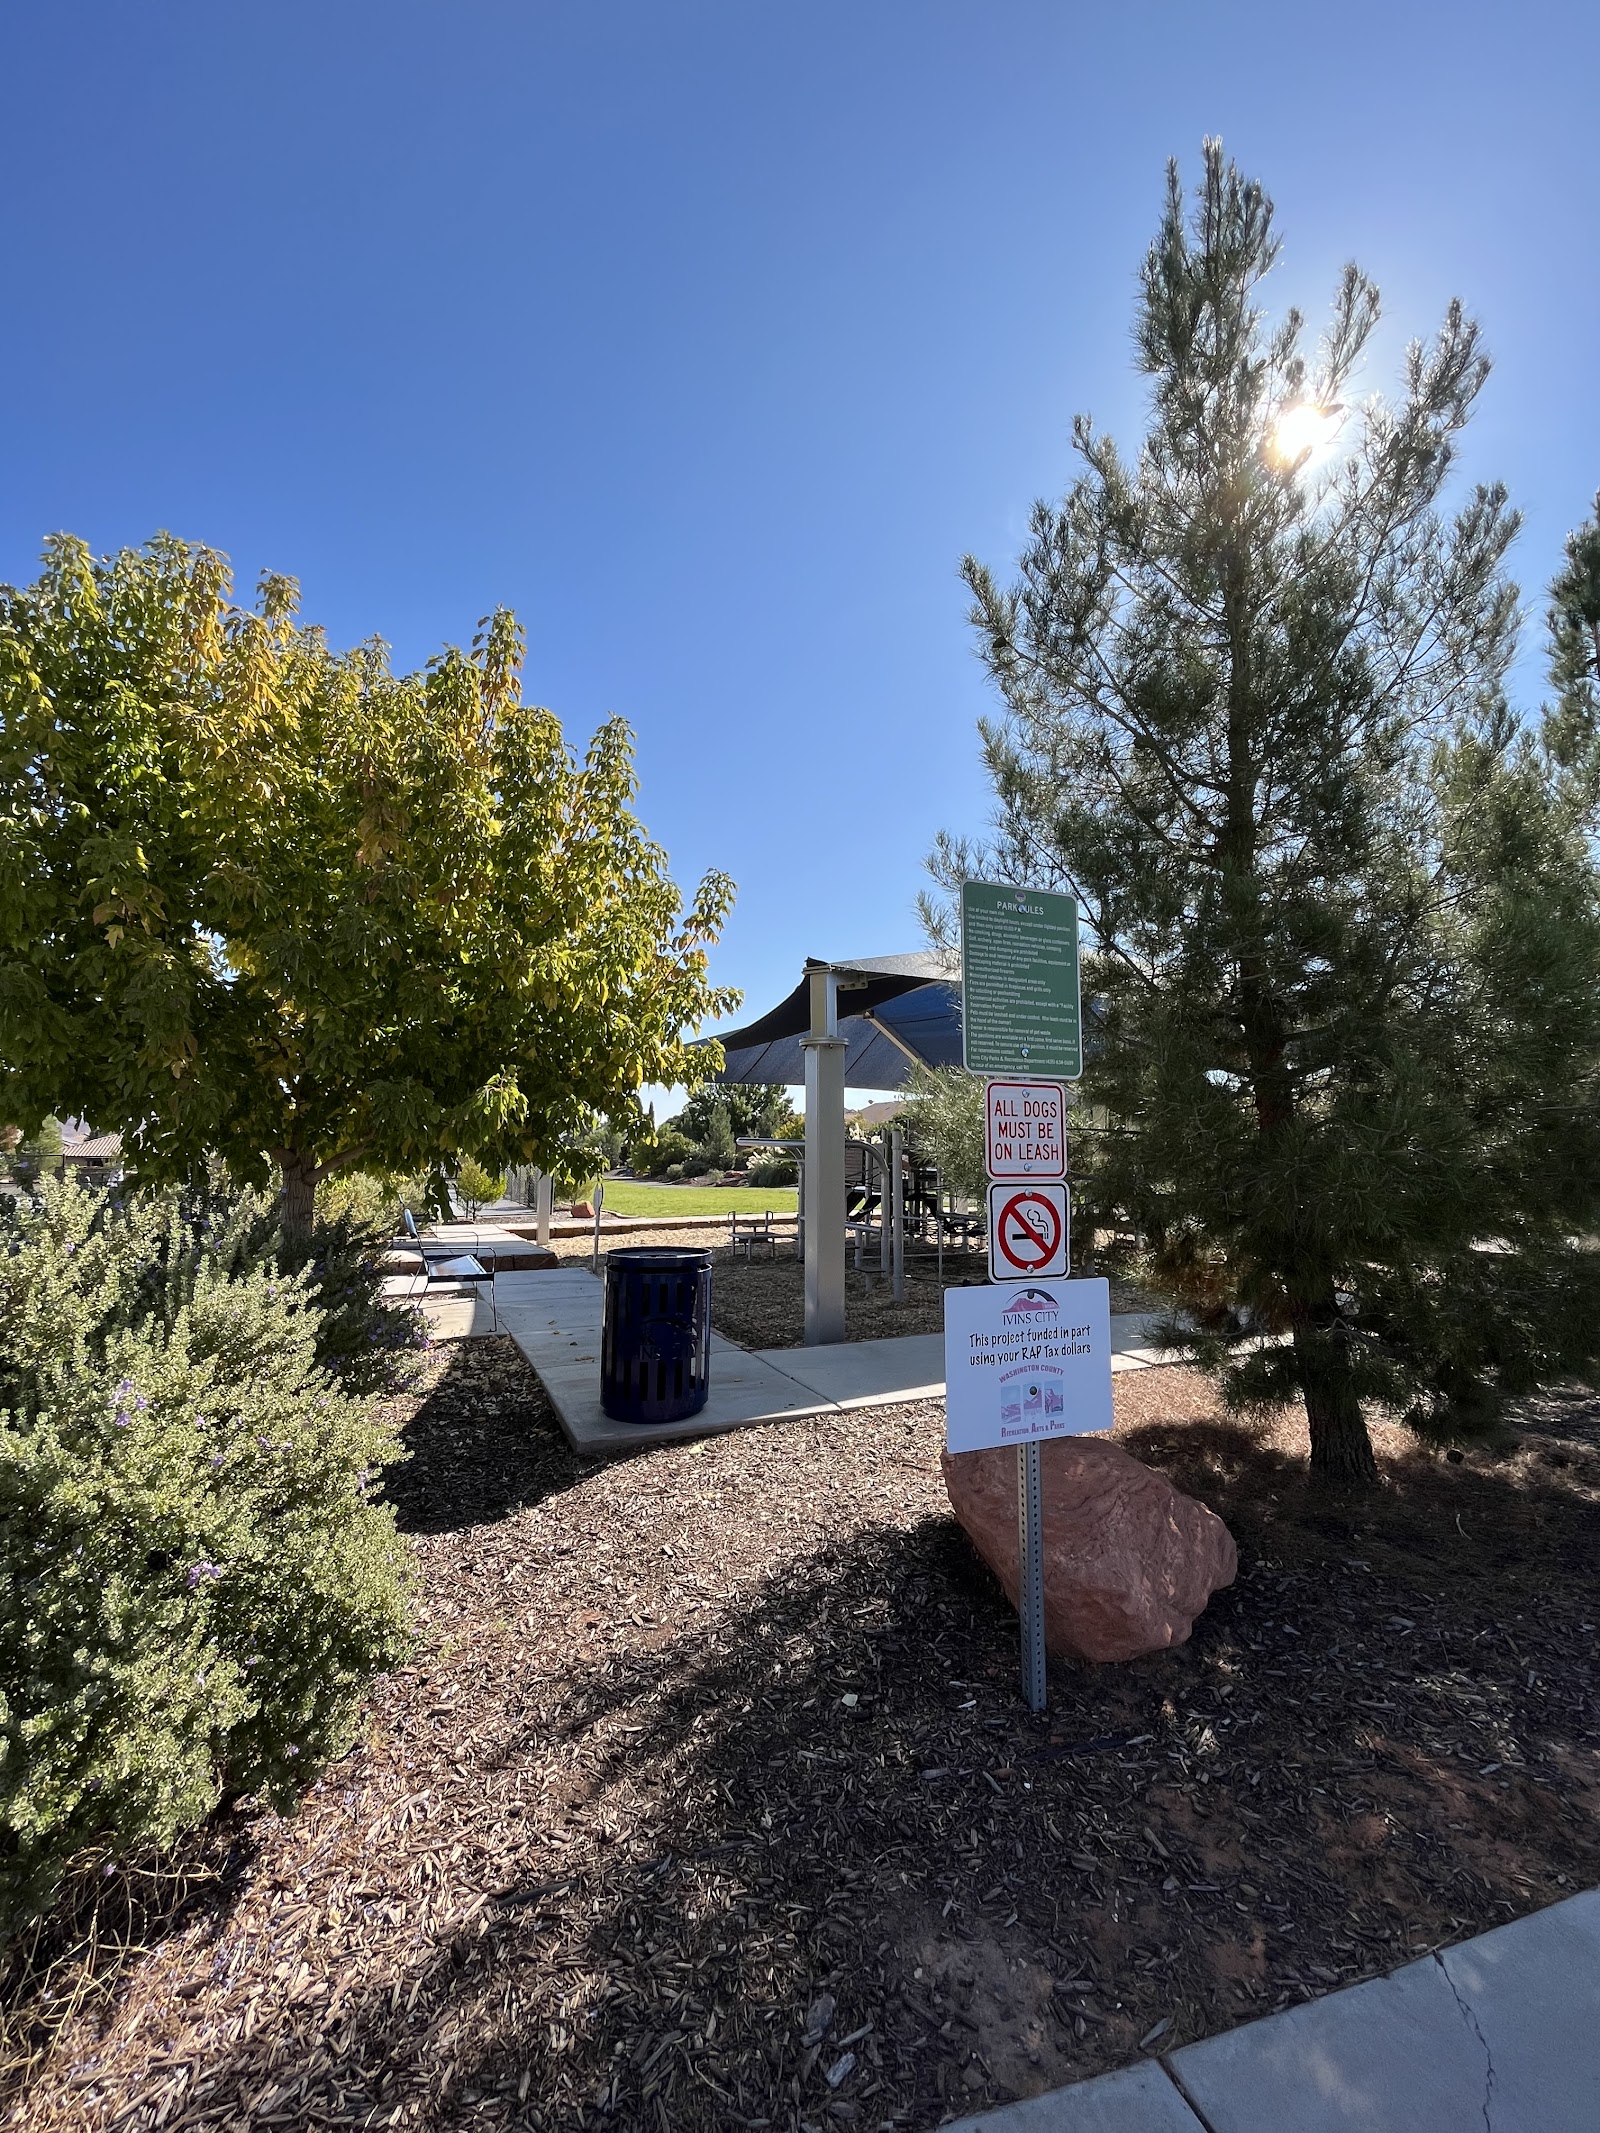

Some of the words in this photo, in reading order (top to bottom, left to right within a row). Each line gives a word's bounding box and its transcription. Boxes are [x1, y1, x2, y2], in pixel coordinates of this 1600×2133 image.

[996, 901, 1018, 912] PARK
[1018, 904, 1044, 916] ULES
[994, 1100, 1018, 1117] ALL
[1024, 1100, 1058, 1118] DOGS
[998, 1122, 1032, 1138] MUST
[1038, 1122, 1054, 1139] BE
[994, 1143, 1012, 1160] ON
[1018, 1143, 1059, 1161] LEASH
[1002, 1312, 1032, 1326] IVINS
[1035, 1310, 1058, 1322] CITY
[969, 1333, 989, 1348] This
[991, 1330, 1024, 1348] project
[1027, 1327, 1058, 1342] funded
[1060, 1326, 1069, 1338] in
[1072, 1324, 1090, 1340] part
[970, 1352, 995, 1366] using
[997, 1350, 1020, 1365] your
[1022, 1346, 1042, 1360] RAP
[1044, 1344, 1059, 1358] Tax
[1062, 1342, 1091, 1356] dollars
[998, 1364, 1040, 1383] WASHINGTON
[1040, 1364, 1064, 1376] COUNTY
